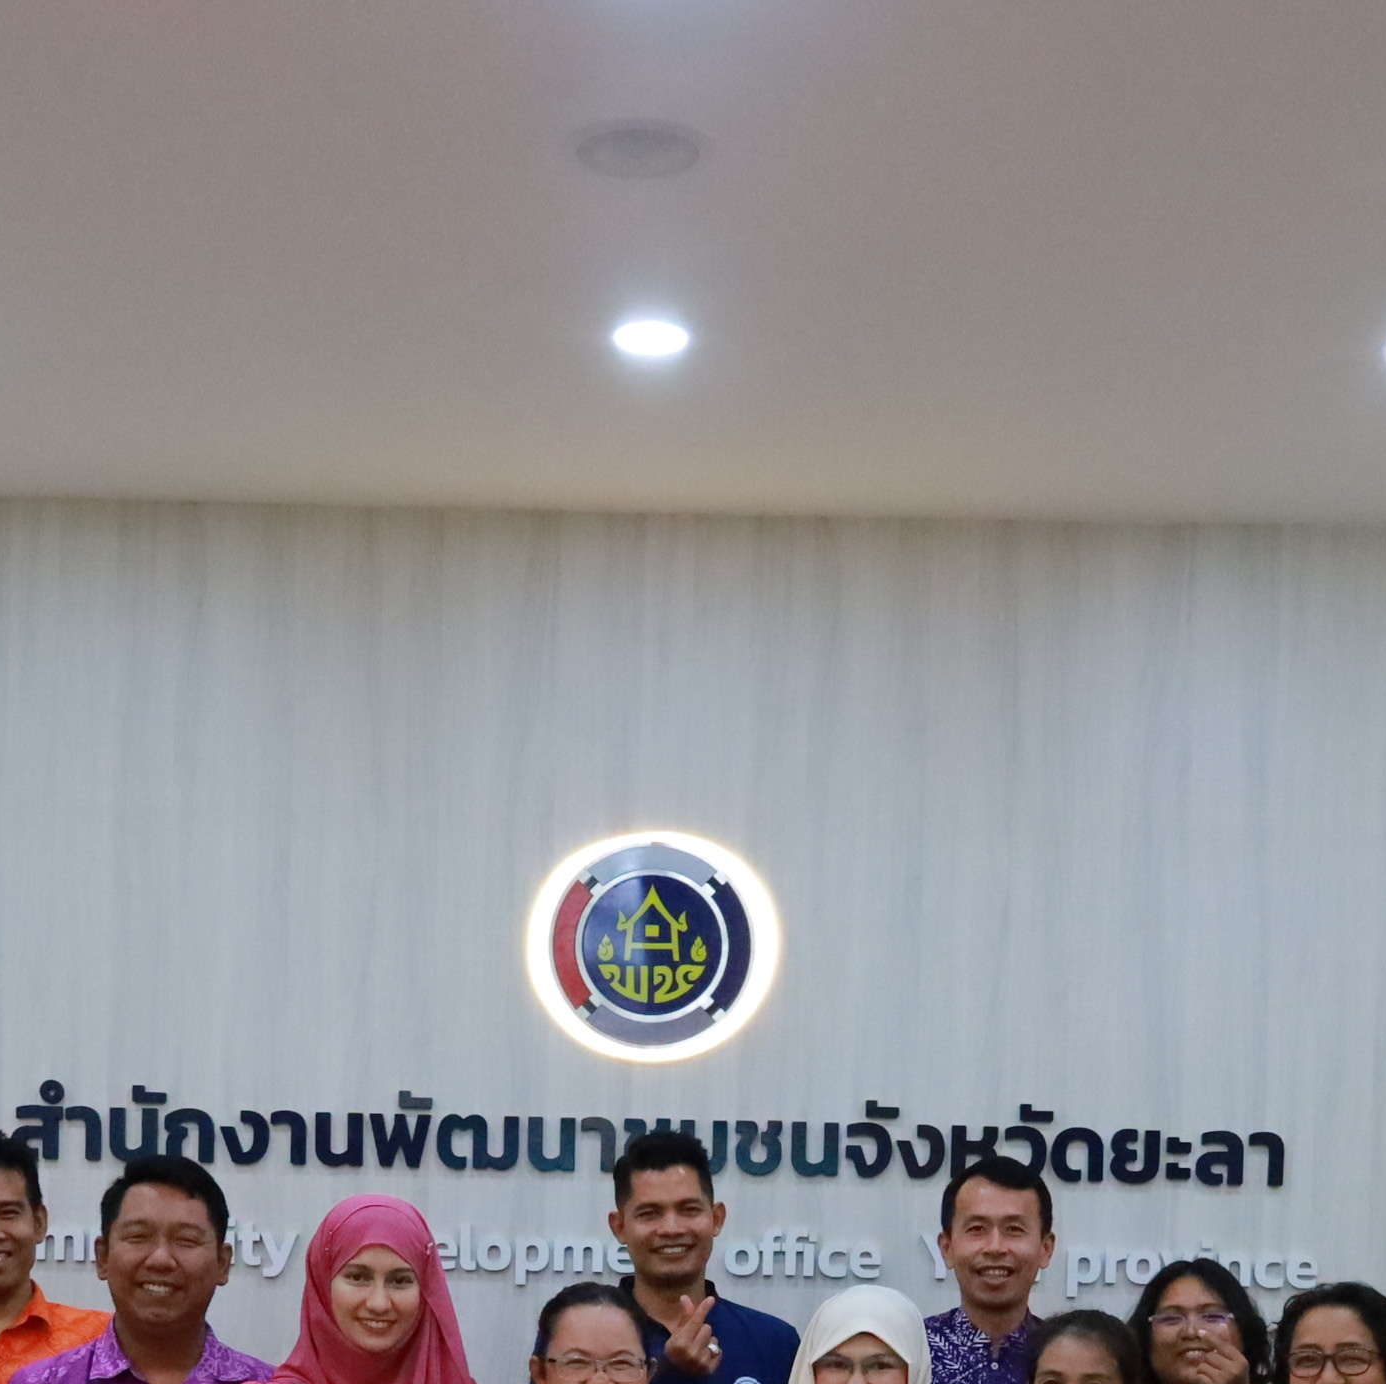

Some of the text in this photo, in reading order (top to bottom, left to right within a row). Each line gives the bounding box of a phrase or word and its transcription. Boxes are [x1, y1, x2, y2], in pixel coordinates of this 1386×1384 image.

[13, 1079, 1286, 1188] สำนักงานพัฒนามชนจังหวัดยะลา
[724, 1227, 882, 1281] office
